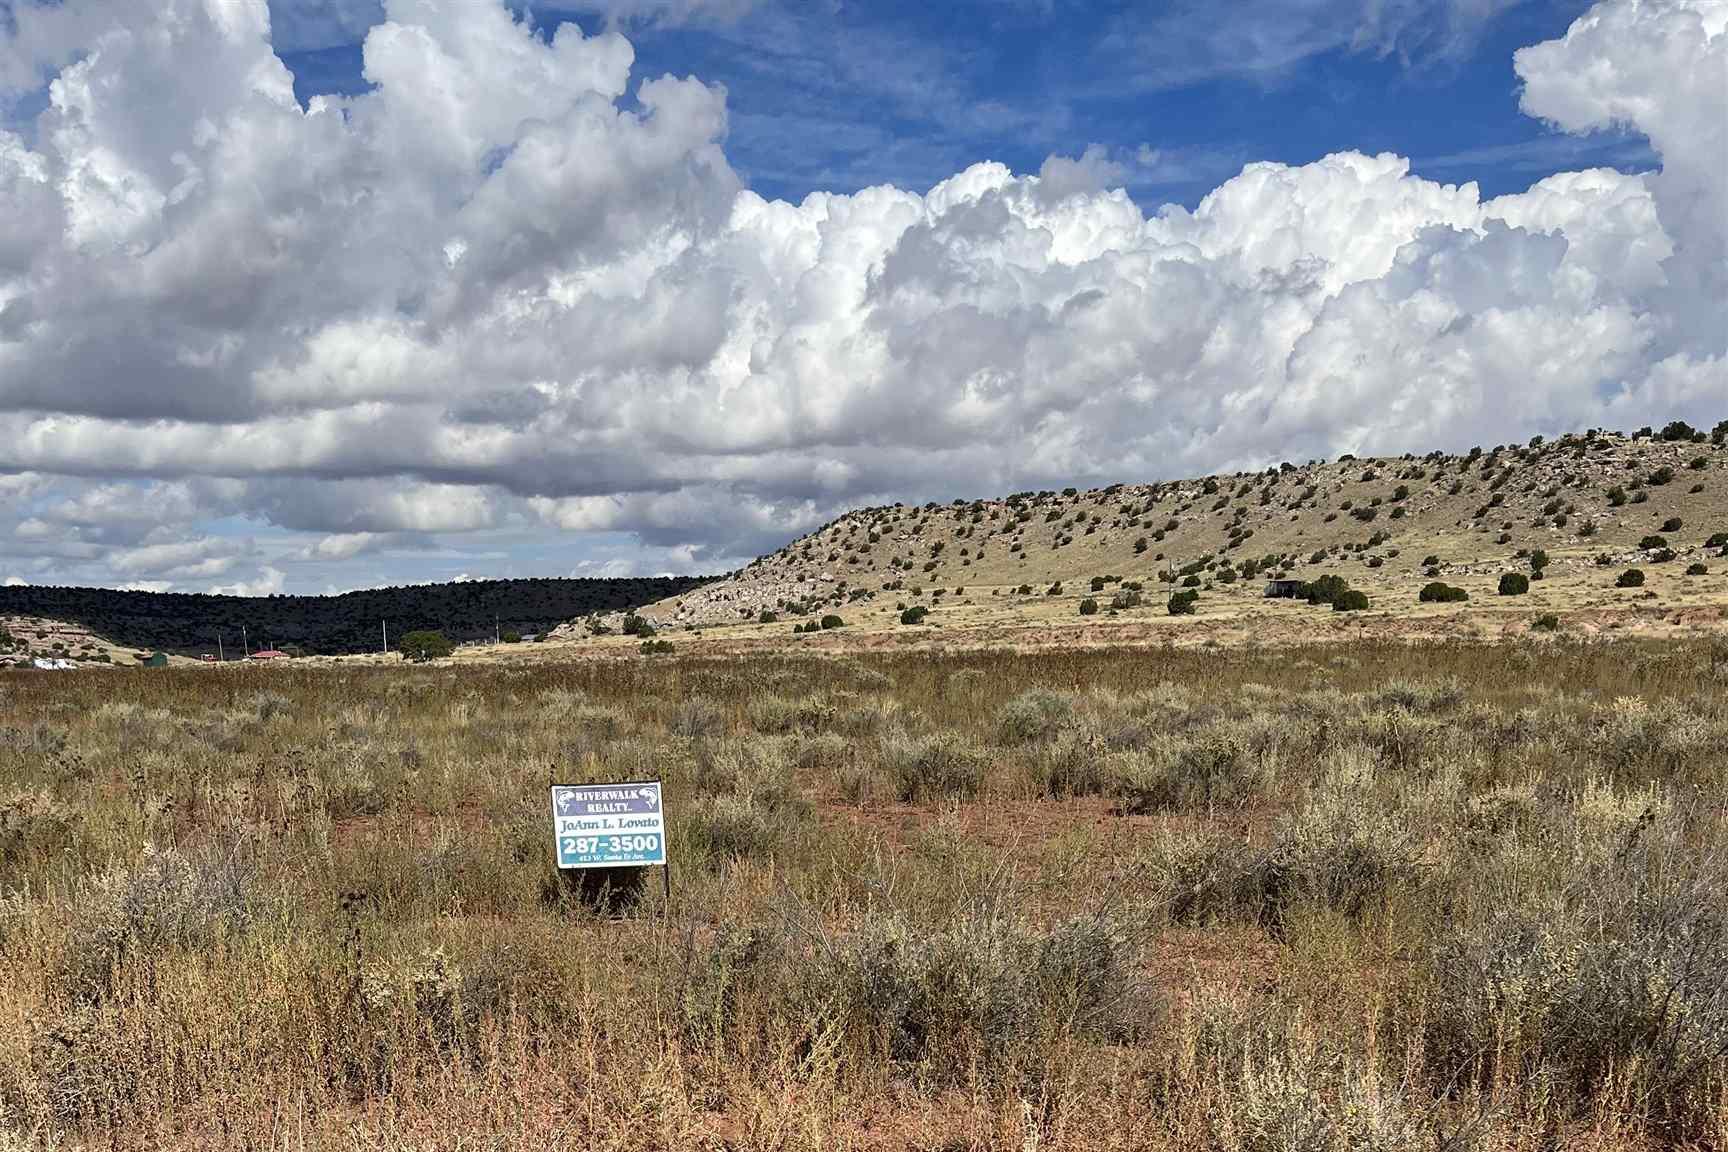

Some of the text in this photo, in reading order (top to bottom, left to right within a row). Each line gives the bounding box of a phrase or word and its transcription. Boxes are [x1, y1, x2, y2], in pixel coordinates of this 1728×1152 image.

[576, 790, 640, 801] RIVERWALK
[561, 818, 659, 834] JoAnn L. Lovato
[563, 835, 658, 854] 287-3500
